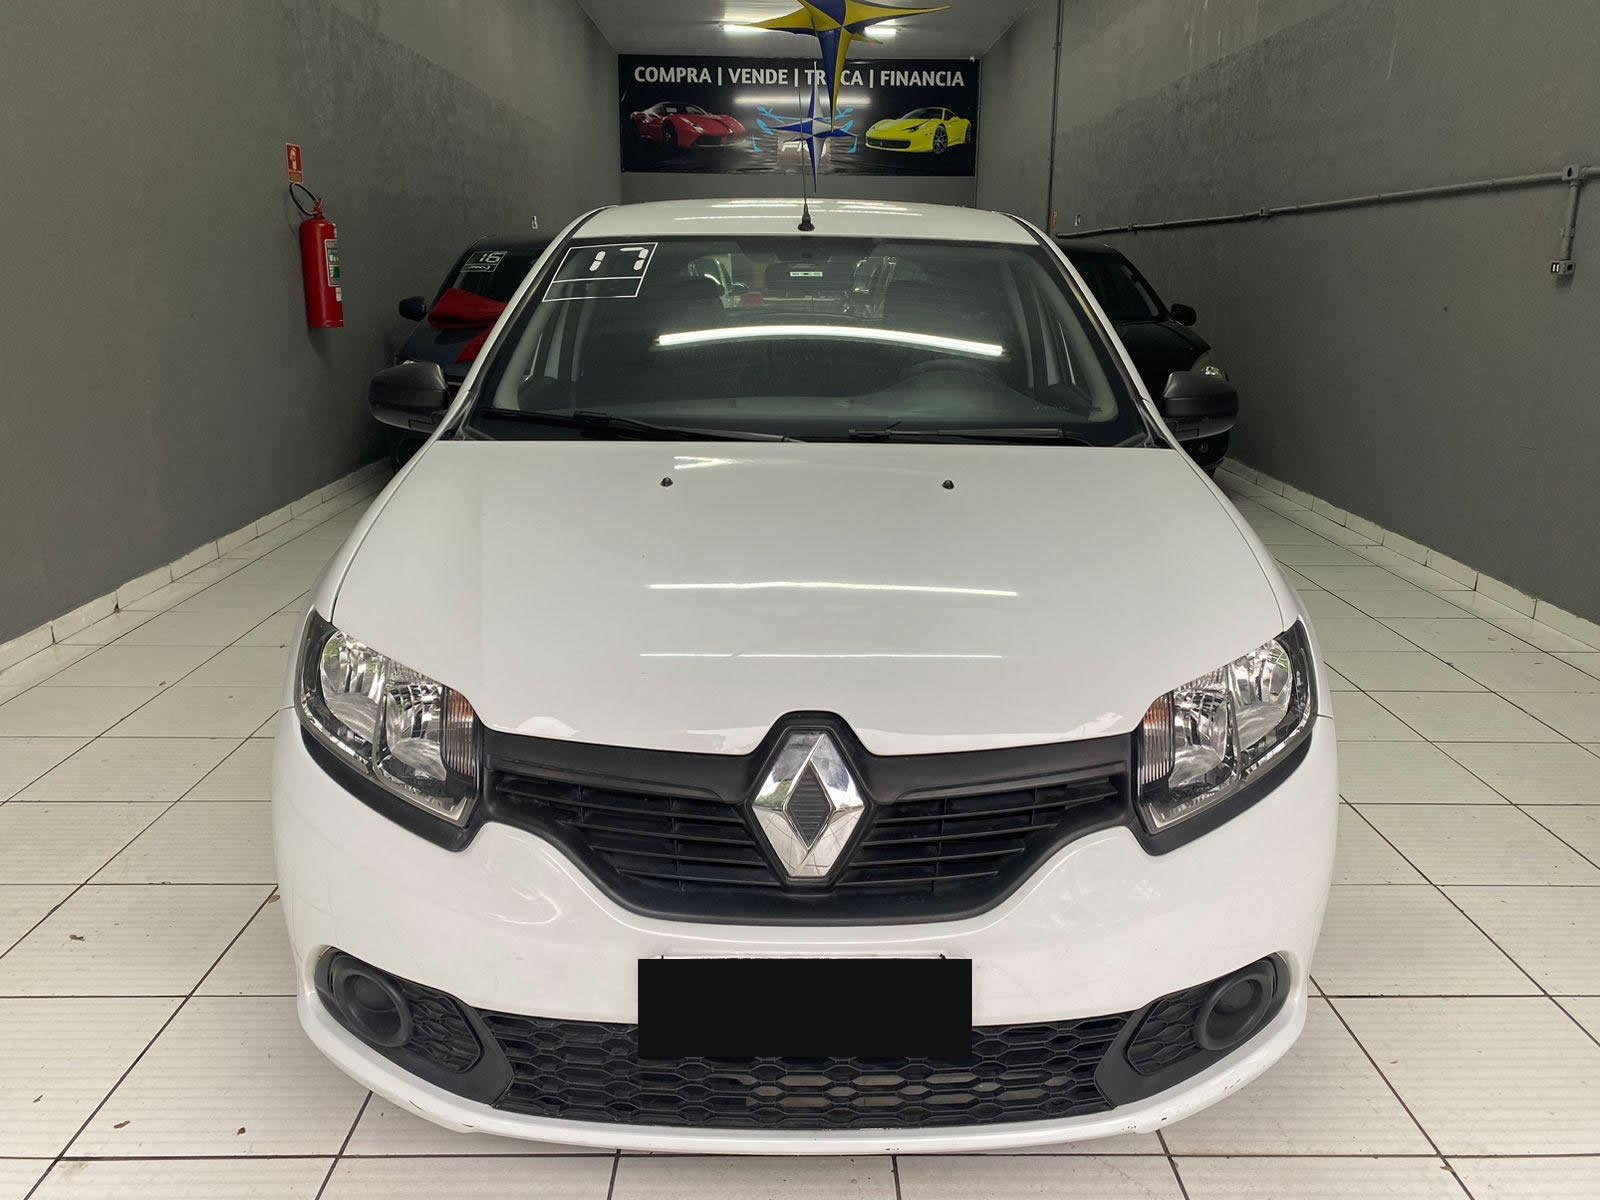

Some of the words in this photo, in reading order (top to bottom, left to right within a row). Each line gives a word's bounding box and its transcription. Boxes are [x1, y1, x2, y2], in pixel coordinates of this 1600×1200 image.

[634, 66, 711, 83] COMPRA
[728, 68, 788, 85] VENDE
[804, 69, 863, 85] TRCA
[880, 70, 964, 87] FINANCIA
[479, 252, 502, 263] 16
[589, 247, 649, 271] 17
